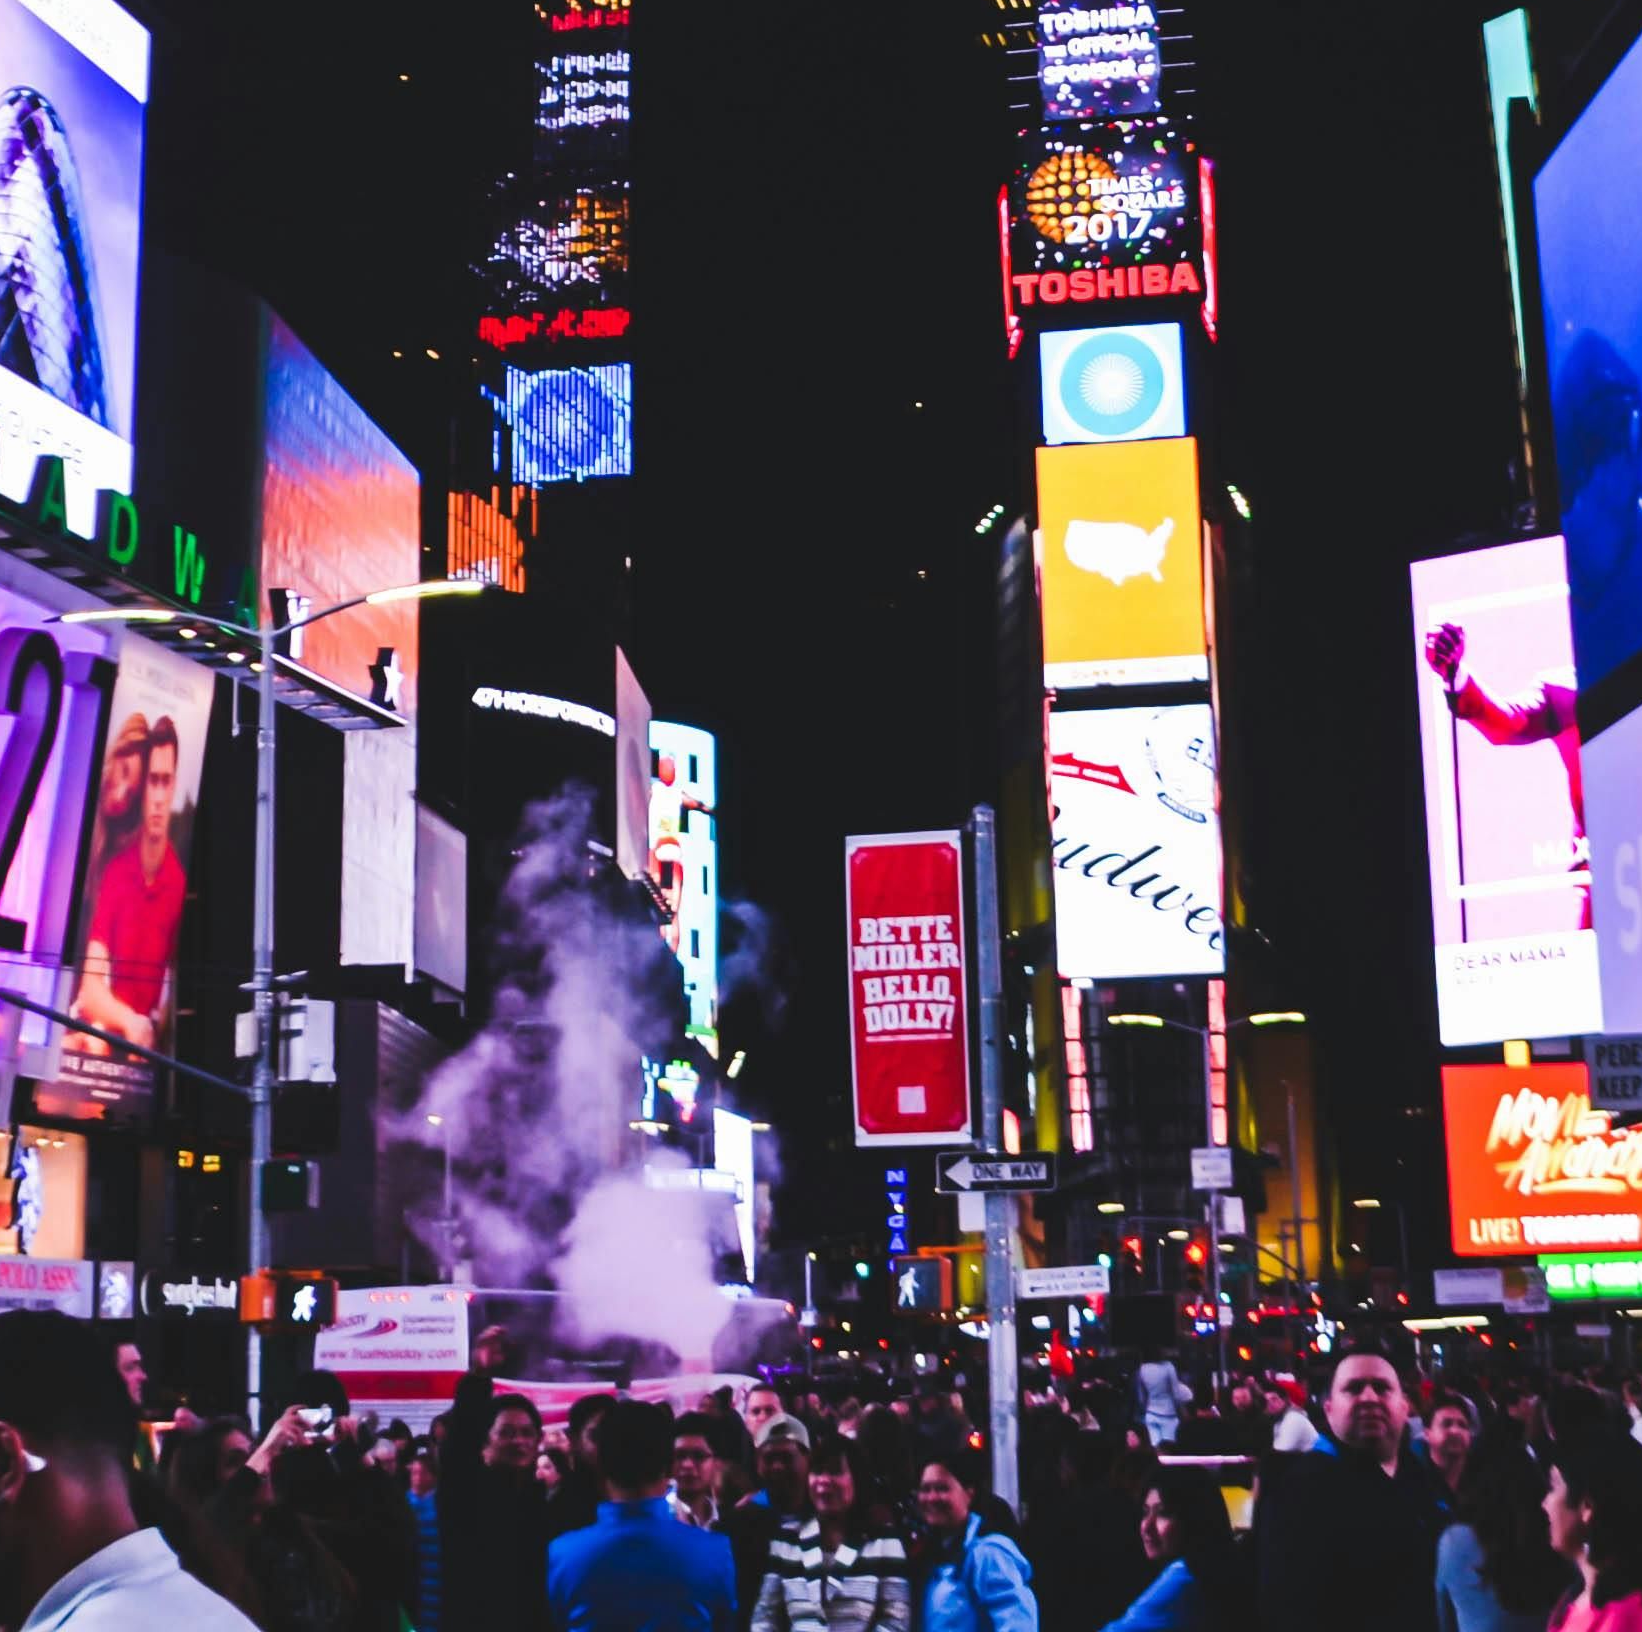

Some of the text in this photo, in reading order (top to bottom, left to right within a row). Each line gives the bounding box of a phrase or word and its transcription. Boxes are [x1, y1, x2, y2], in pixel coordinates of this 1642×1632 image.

[1038, 5, 1156, 34] TOSHIBA
[1067, 31, 1156, 56] OFFICIAL
[1043, 58, 1136, 85] SPONSOR
[1085, 174, 1154, 197] TIMES
[1100, 186, 1186, 216] SQUARE
[1064, 210, 1154, 244] 2017
[1012, 261, 1202, 306] TOSHIBA
[1052, 808, 1222, 951] udwe
[859, 914, 953, 944] BETTE
[853, 942, 961, 971] MIDLER
[862, 974, 956, 1005] HELLO,
[863, 1001, 956, 1033] DOLLY!
[1597, 1074, 1642, 1100] KEEP
[973, 1162, 1045, 1180] ONE WAY
